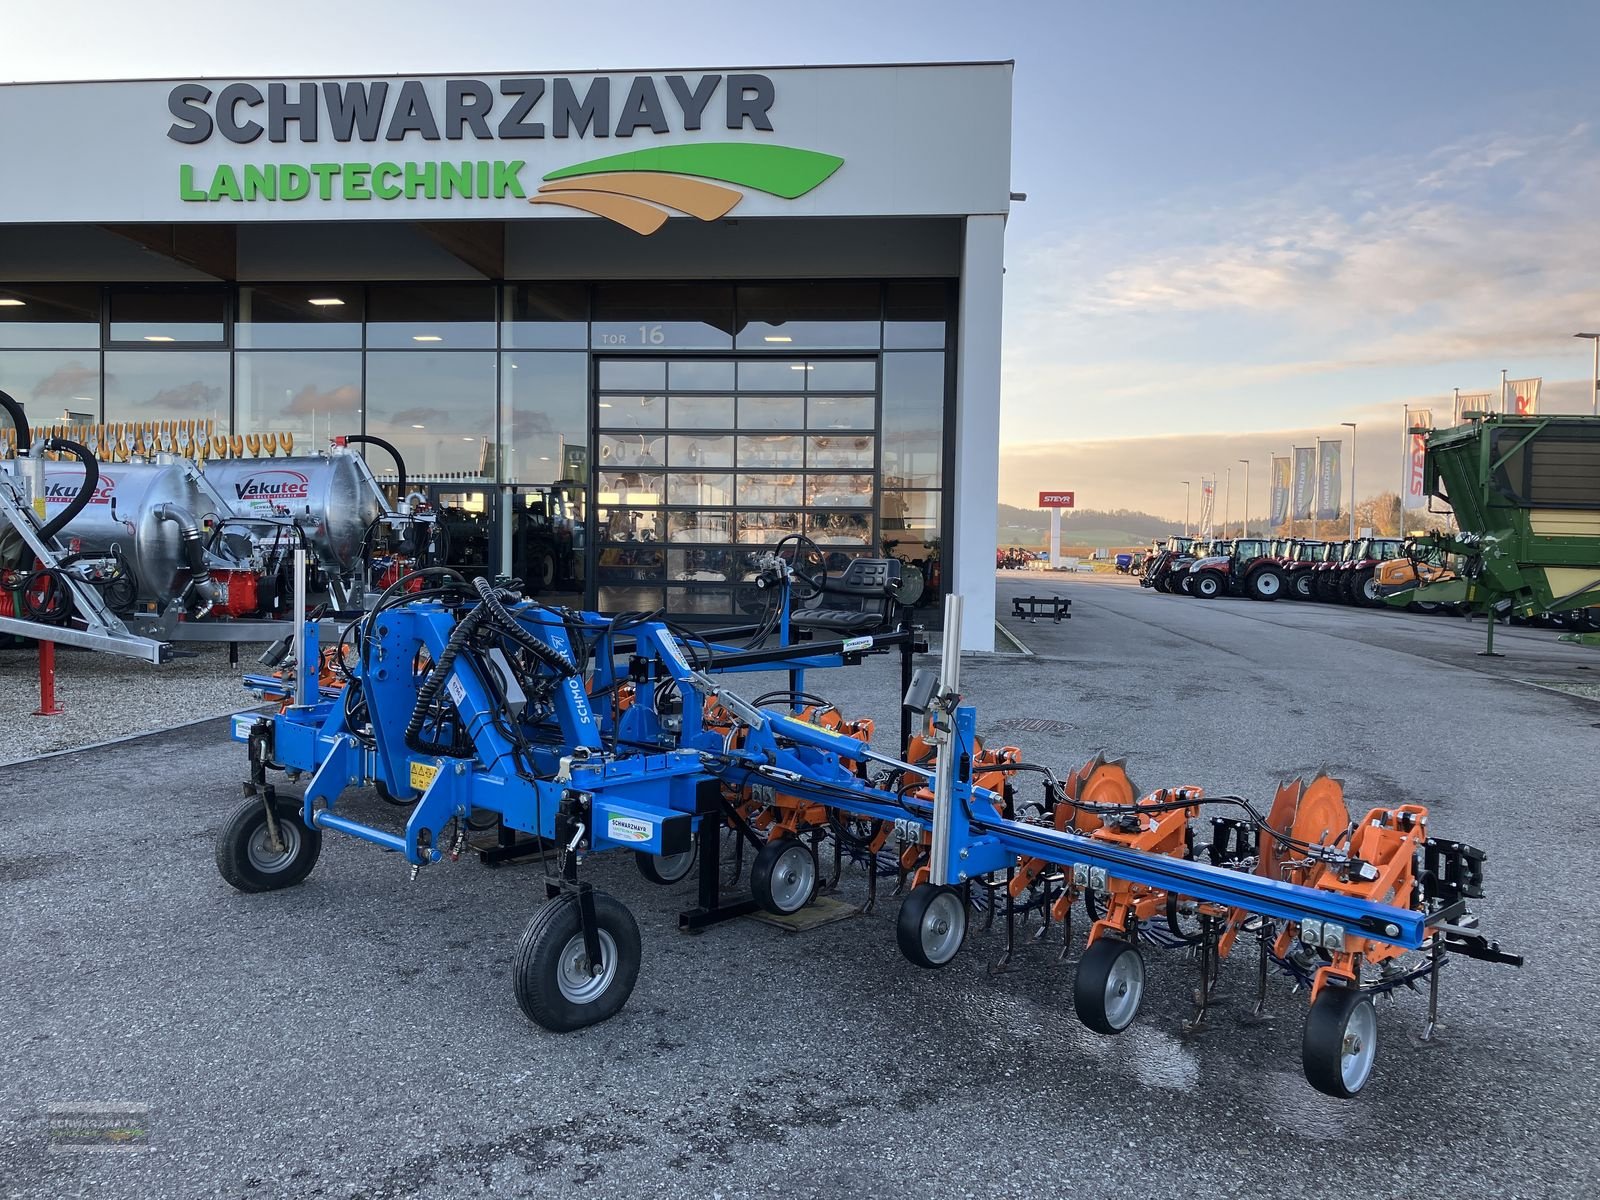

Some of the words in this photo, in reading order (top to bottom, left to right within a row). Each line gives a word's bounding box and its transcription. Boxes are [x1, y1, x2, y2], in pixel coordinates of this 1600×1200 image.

[166, 73, 776, 145] SCHWARZMAYR
[179, 160, 526, 202] LANDTECHNIK
[602, 334, 627, 345] TOR
[639, 324, 665, 345] 16
[235, 478, 309, 500] Vakutec
[1043, 495, 1071, 504] STEYR
[559, 648, 591, 724] SCHMOR
[611, 819, 647, 832] SCHWARZMAYR
